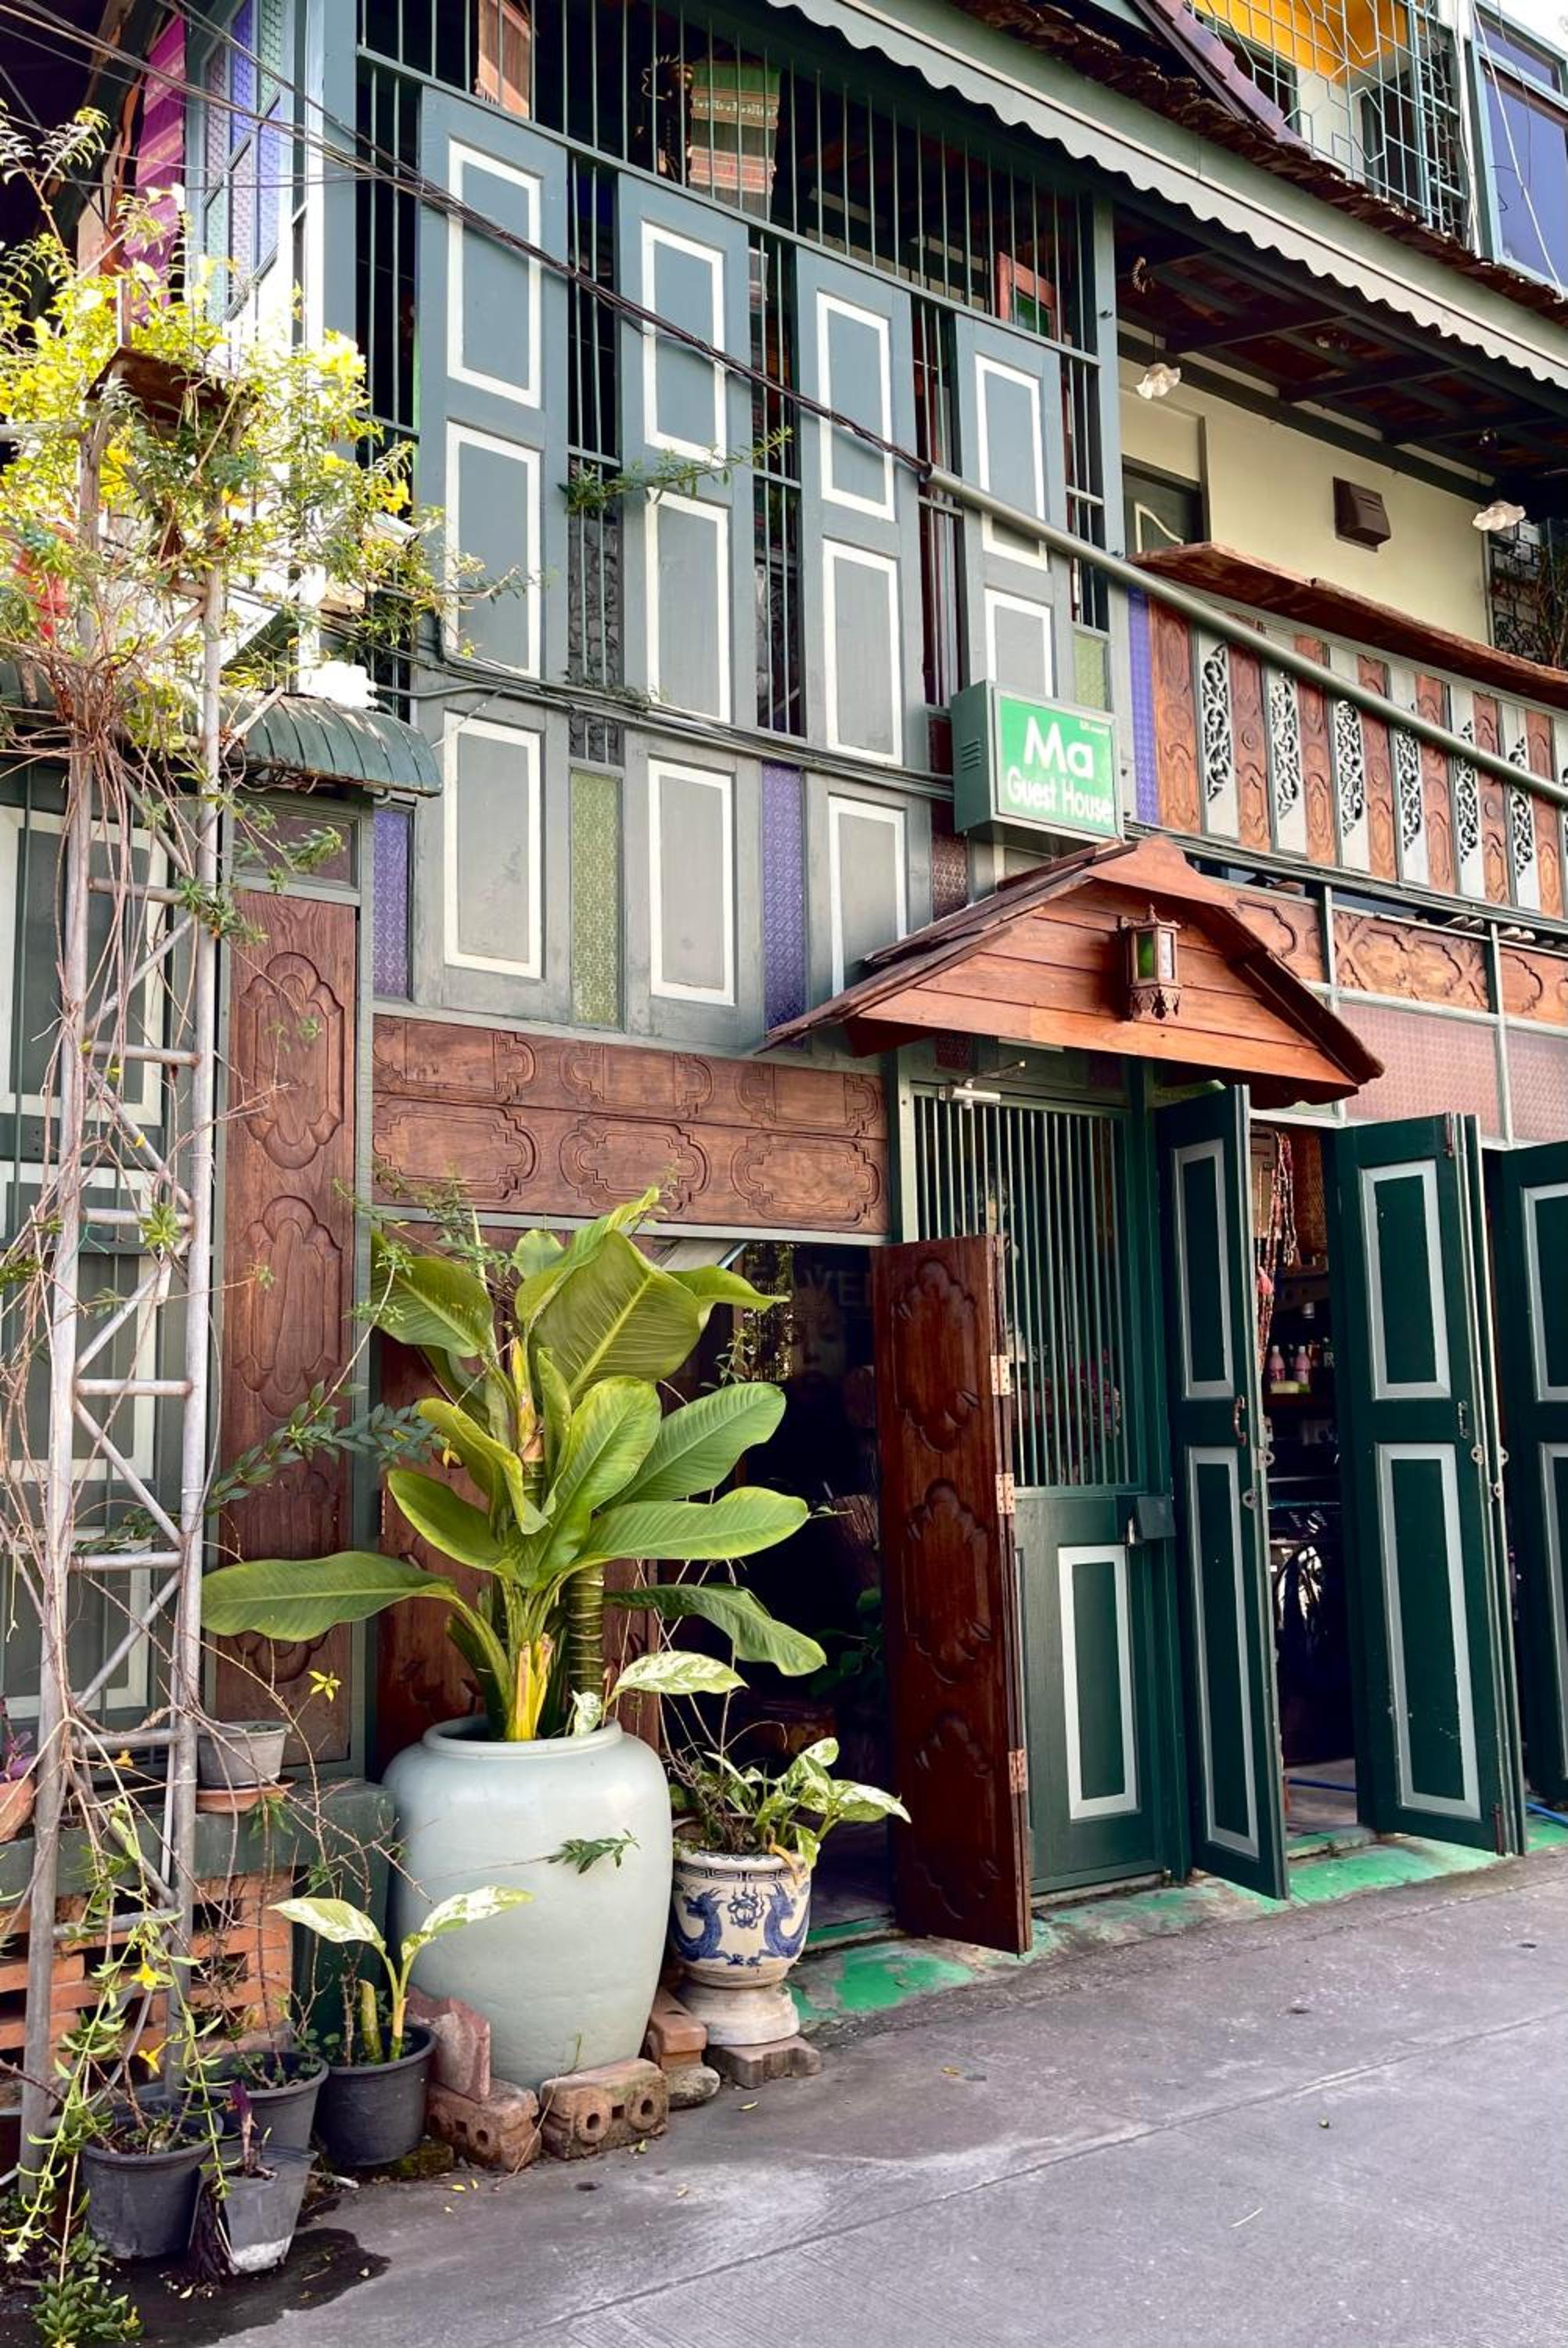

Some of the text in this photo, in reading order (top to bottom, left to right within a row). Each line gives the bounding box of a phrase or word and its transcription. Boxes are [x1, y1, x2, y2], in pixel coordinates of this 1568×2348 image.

[1023, 715, 1095, 779] Ma
[1007, 766, 1114, 823] Guest House
